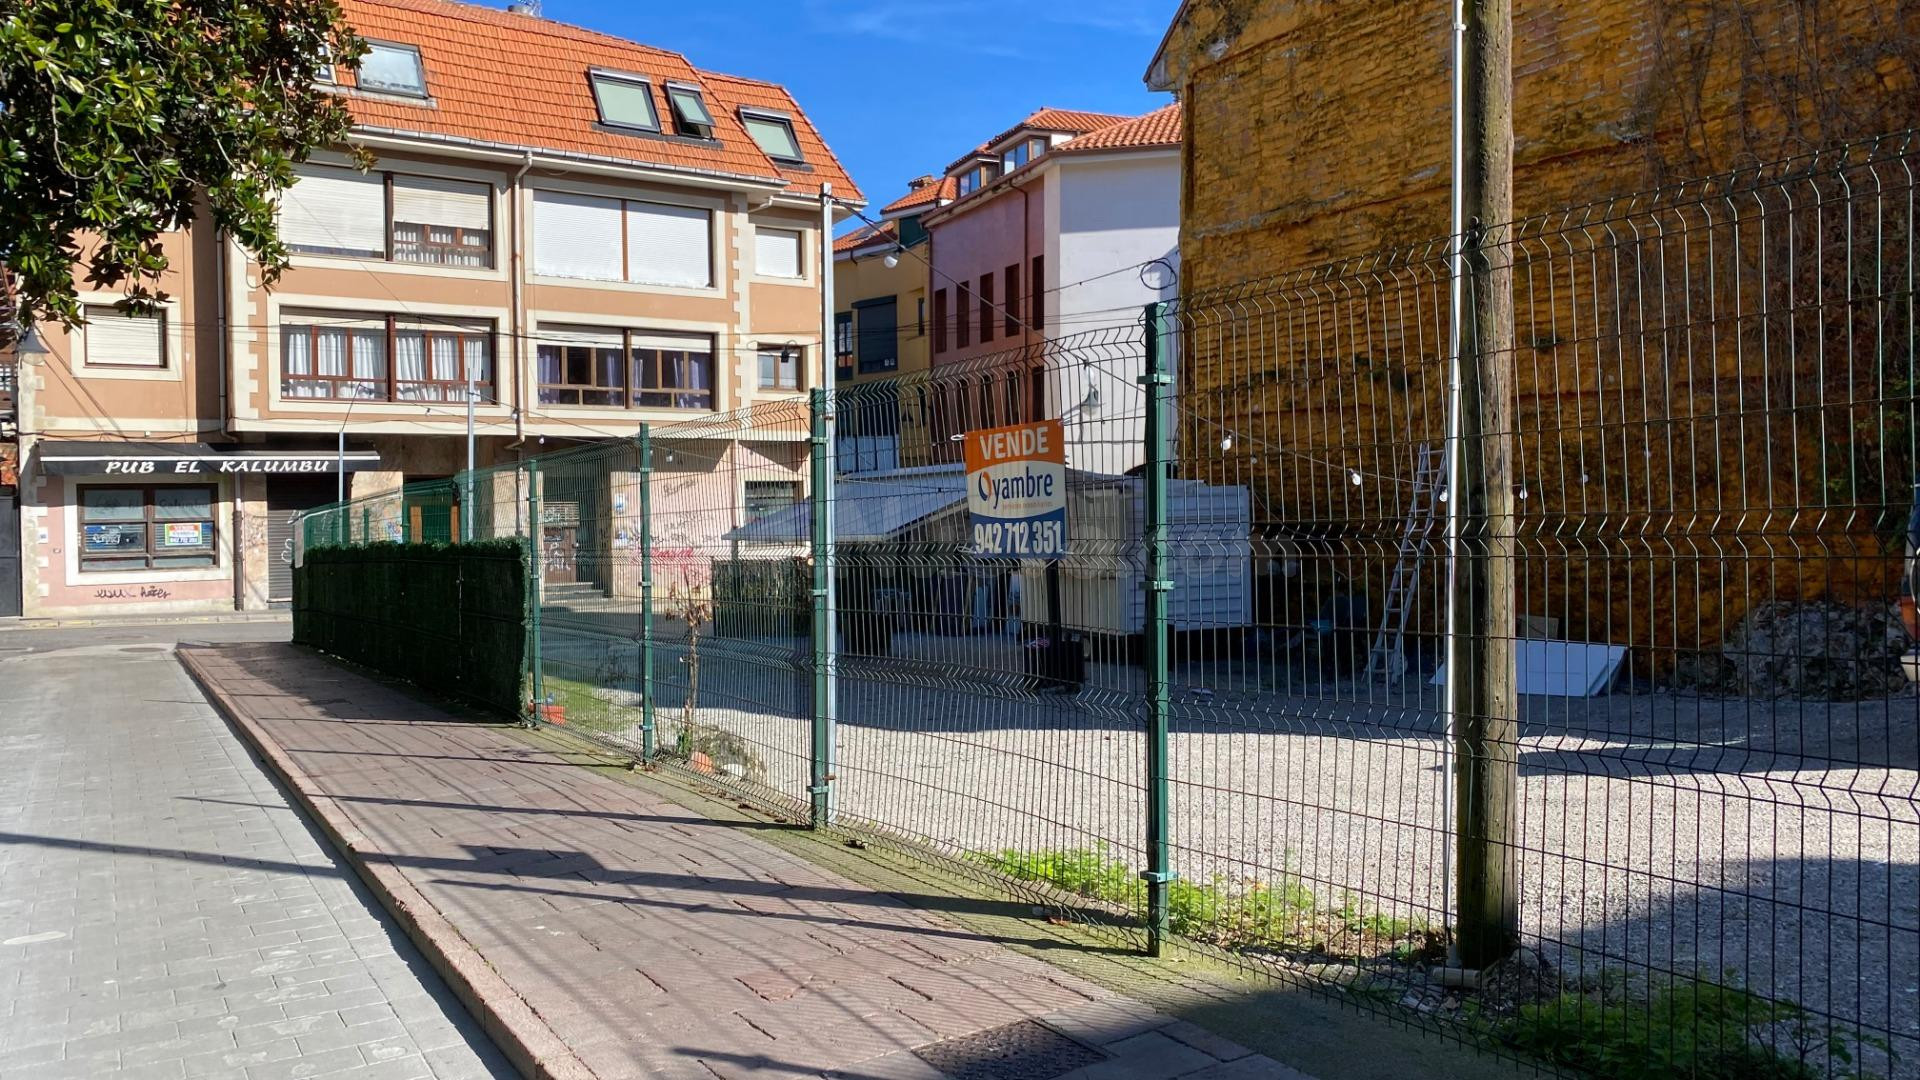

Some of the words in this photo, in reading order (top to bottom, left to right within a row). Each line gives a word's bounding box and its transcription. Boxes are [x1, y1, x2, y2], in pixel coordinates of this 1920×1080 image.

[979, 426, 1049, 460] VENDE
[105, 461, 155, 474] PUB
[174, 461, 201, 473] EL
[219, 460, 330, 473] KALUMBU
[978, 466, 1053, 509] Oyambre
[974, 522, 1003, 554] 942
[1005, 521, 1029, 554] 712
[1032, 520, 1062, 554] 351
